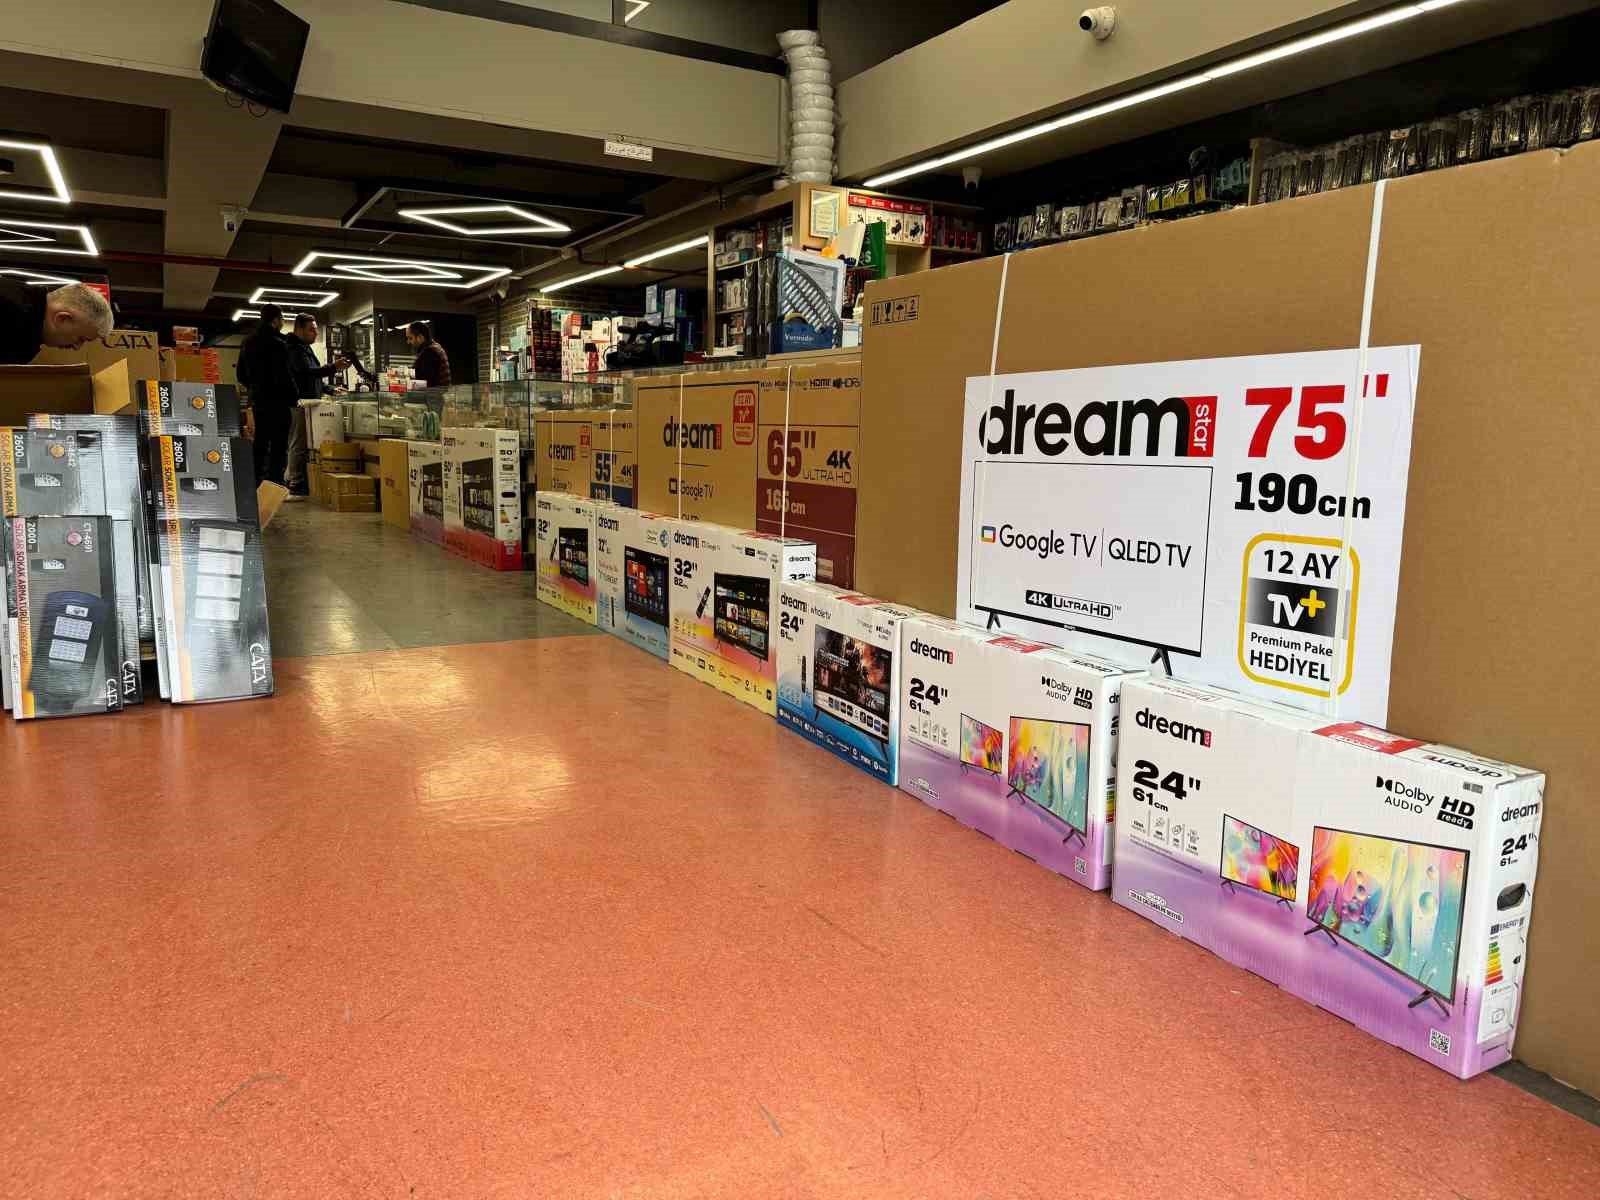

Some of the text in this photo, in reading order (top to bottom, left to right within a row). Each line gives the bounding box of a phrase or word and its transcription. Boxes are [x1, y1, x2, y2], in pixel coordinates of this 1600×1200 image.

[101, 334, 152, 349] CATA
[160, 386, 169, 408] 2600
[979, 389, 1212, 456] dream star
[1245, 373, 1389, 460] 75"
[663, 416, 716, 450] dream
[15, 434, 24, 458] 2600
[174, 441, 183, 463] 2600
[767, 429, 817, 477] 65"
[622, 464, 633, 477] 4K
[827, 450, 852, 469] 4K
[803, 468, 852, 484] ULTRA HD
[680, 479, 714, 500] Google TV
[1235, 472, 1371, 519] 190cm
[27, 522, 36, 544] 2000
[674, 529, 697, 549] dream
[1000, 524, 1097, 559] Google TV
[1109, 537, 1192, 568] QLED TV
[16, 551, 26, 578] SOKAK
[674, 558, 698, 579] 32"
[1264, 549, 1340, 579] 12 AY
[780, 592, 805, 612] dream
[1027, 591, 1048, 606] 4K
[780, 611, 804, 632] 24"
[910, 637, 949, 664] dream
[1250, 631, 1301, 651] Premium
[249, 643, 267, 684] CATA
[122, 660, 136, 696] CATA
[1050, 678, 1072, 696] Dolby
[106, 678, 117, 707] CATA
[910, 677, 948, 706] 24"
[1046, 689, 1067, 701] AUDIO
[1075, 687, 1093, 701] HD
[1135, 707, 1204, 746] dream
[1133, 760, 1201, 800] 24"
[1133, 787, 1169, 812] 61cm
[1384, 795, 1423, 814] AUDIO
[1394, 781, 1434, 807] Dolby
[1440, 795, 1475, 817] HD
[1501, 803, 1538, 823] dream
[1441, 813, 1470, 829] ready
[1501, 832, 1534, 857] 24"
